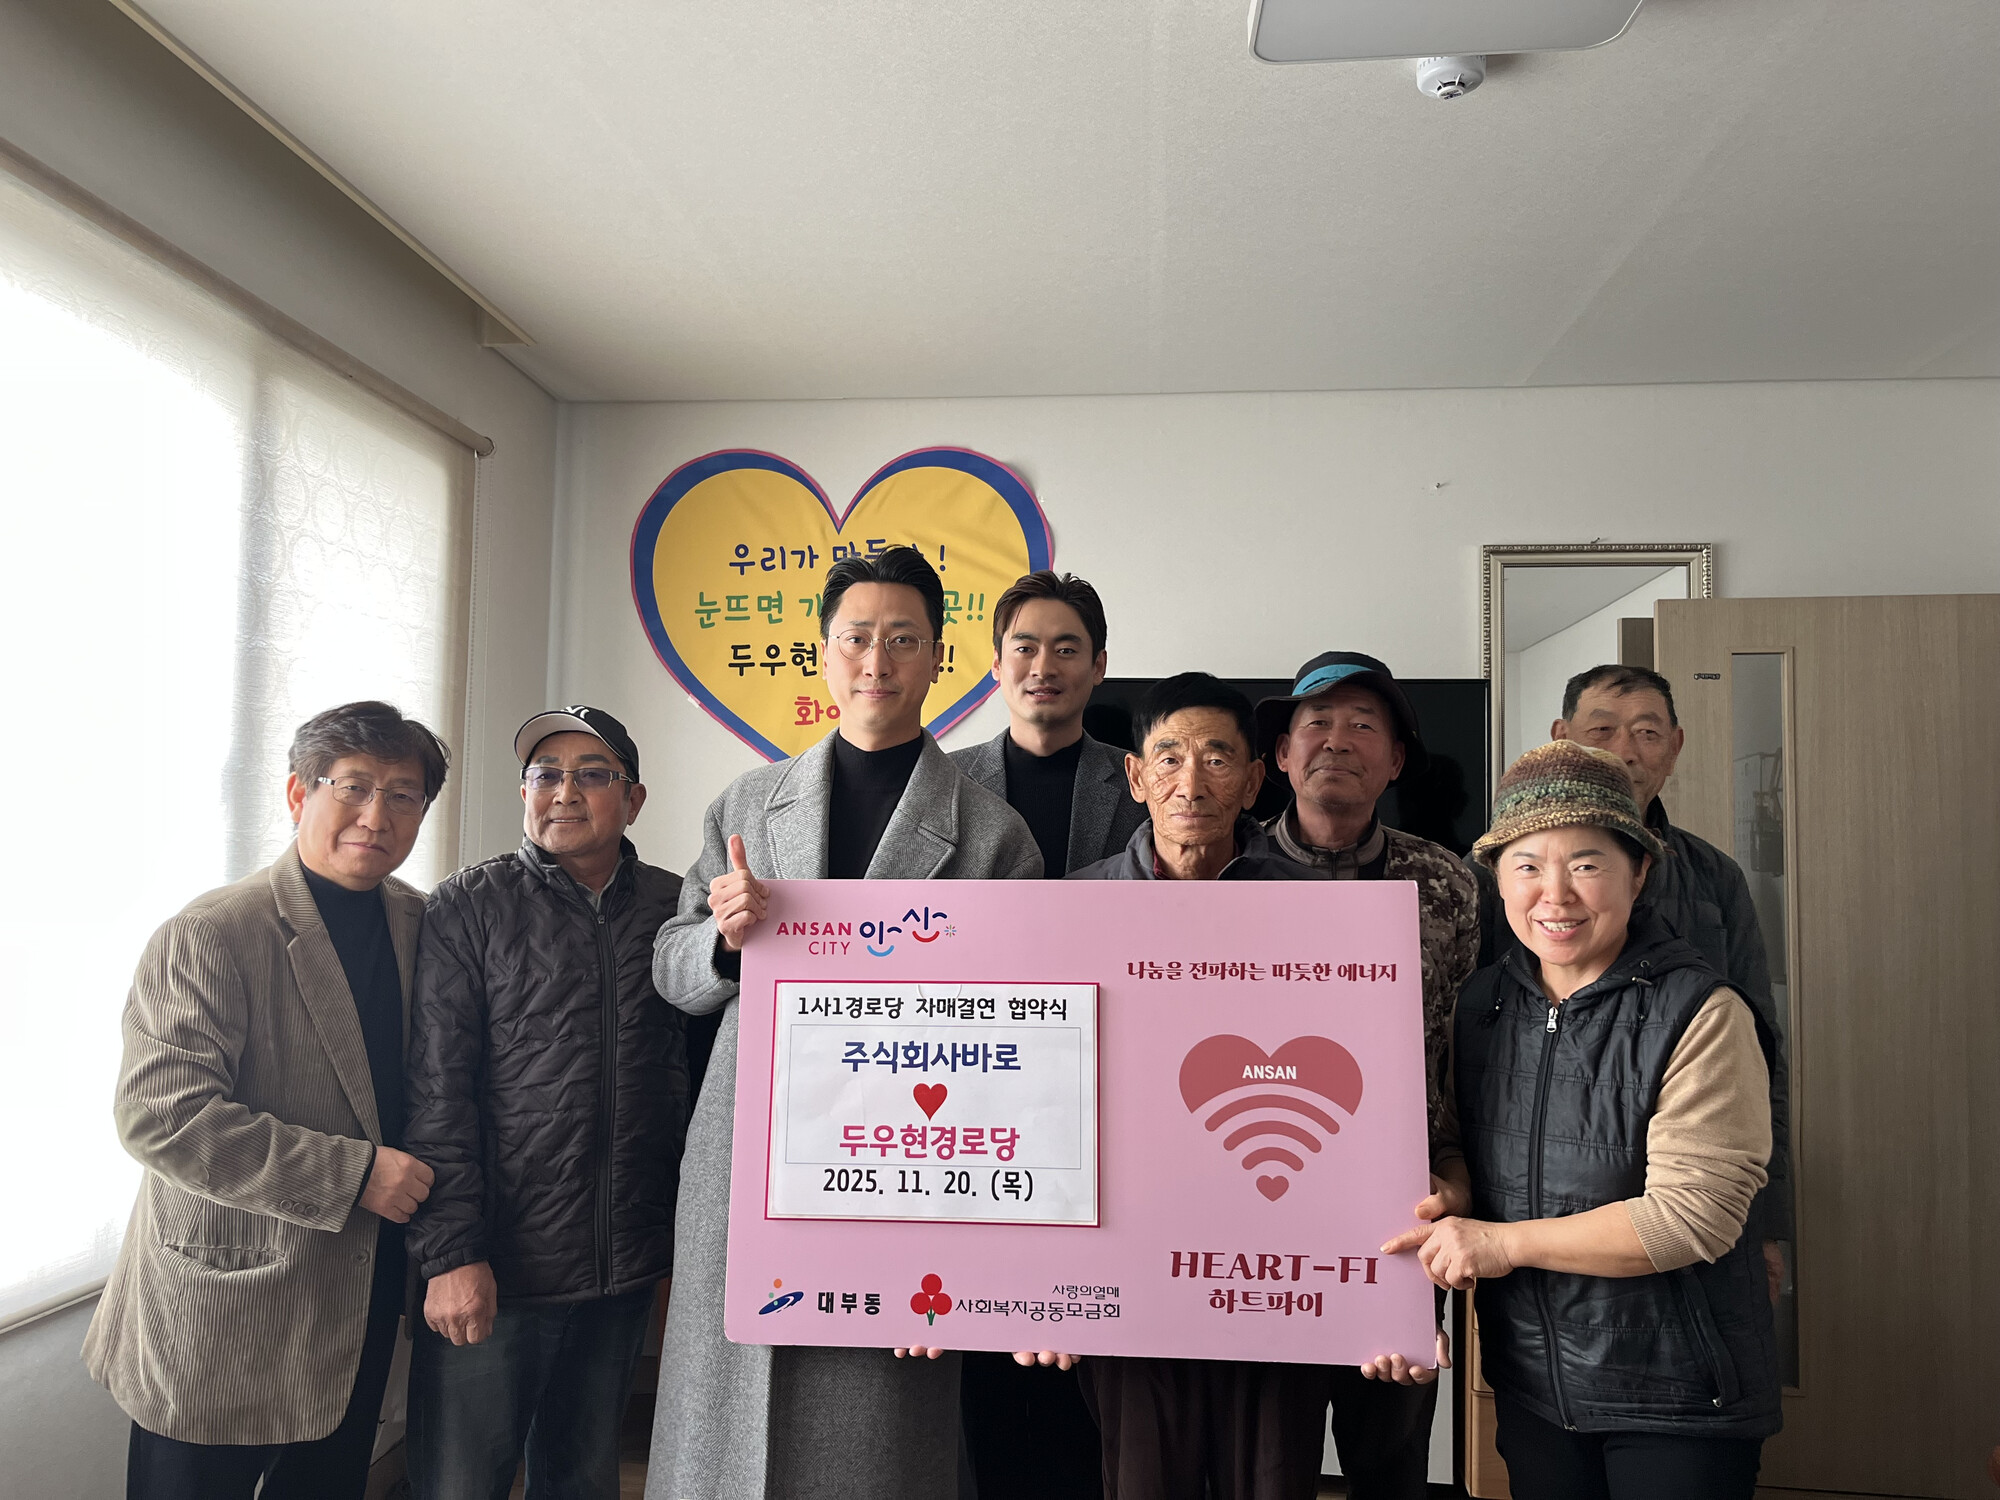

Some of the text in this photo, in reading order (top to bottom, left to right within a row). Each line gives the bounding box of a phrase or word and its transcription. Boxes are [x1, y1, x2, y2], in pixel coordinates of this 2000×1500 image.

[729, 543, 819, 576] 우리가
[694, 590, 784, 629] 눈뜨면
[776, 922, 852, 936] ANSAN
[808, 941, 851, 956] CITY
[1127, 961, 1398, 982] 나눔을 전파하는 따듯한 에너지
[798, 997, 1068, 1021] 1사1경로당 자매결연 협약식
[841, 1040, 1022, 1074] 주식회사바로
[1242, 1064, 1297, 1080] ANSAN
[839, 1123, 1021, 1162] 두우현경로당
[822, 1168, 1034, 1202] 2025. 11. 20. (목)
[1170, 1251, 1379, 1285] HEART-FI
[817, 1291, 881, 1316] 대부동
[1052, 1284, 1120, 1301] 사랑의열매
[1208, 1288, 1323, 1318] 하트파이
[955, 1298, 1121, 1323] 사회복지공동모금회
